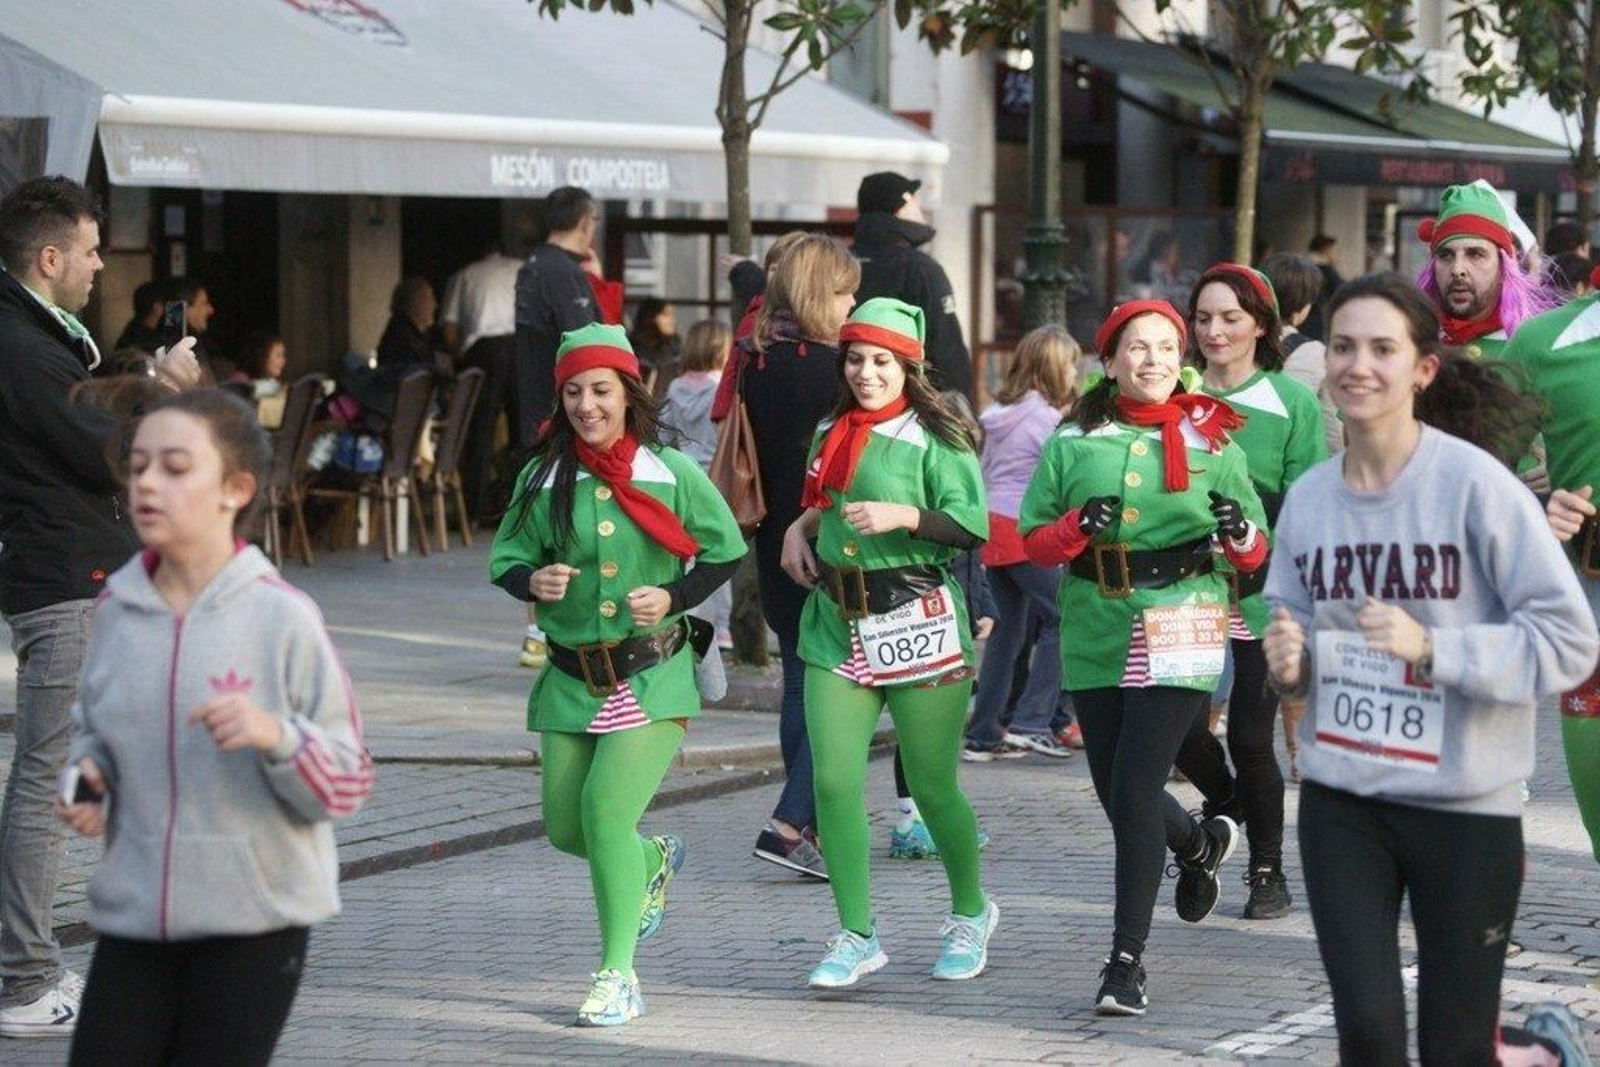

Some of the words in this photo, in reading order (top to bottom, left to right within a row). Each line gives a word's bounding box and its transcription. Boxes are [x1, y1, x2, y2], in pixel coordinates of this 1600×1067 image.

[490, 150, 555, 187] MESÓN
[877, 628, 946, 666] 0827
[1334, 692, 1424, 740] 0618
